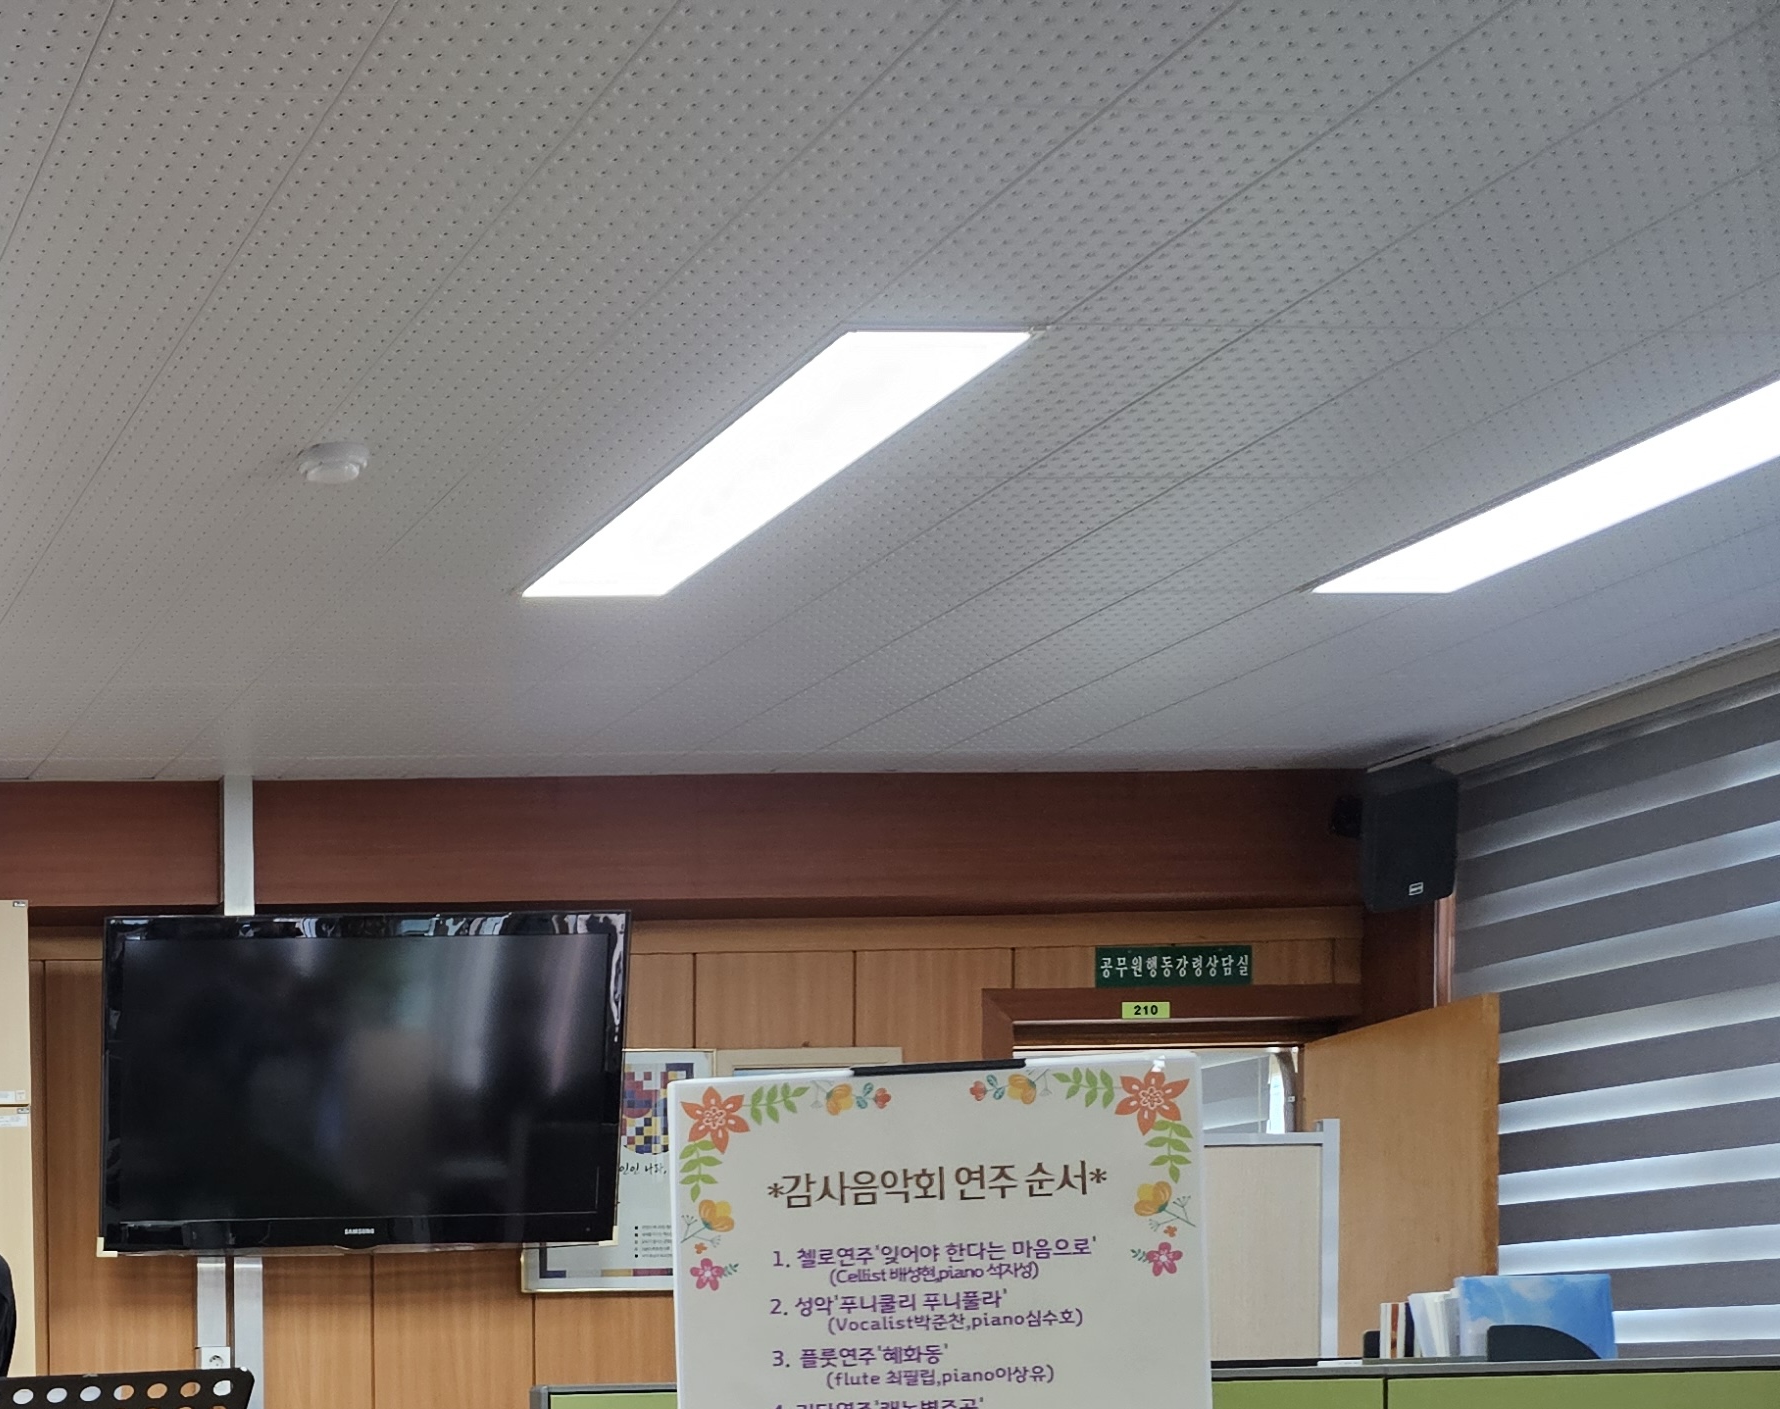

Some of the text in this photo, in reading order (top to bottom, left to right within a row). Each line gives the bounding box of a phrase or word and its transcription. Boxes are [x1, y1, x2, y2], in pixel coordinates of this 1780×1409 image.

[1100, 955, 1249, 978] 공무원행동강령상담실
[1133, 1004, 1159, 1016] 210
[955, 1165, 1018, 1200] 연주
[773, 1249, 790, 1268] 1.
[945, 1241, 1006, 1263] 한다는
[770, 1298, 788, 1315] 2.
[772, 1350, 790, 1367] 3.
[826, 1372, 881, 1390] (flute
